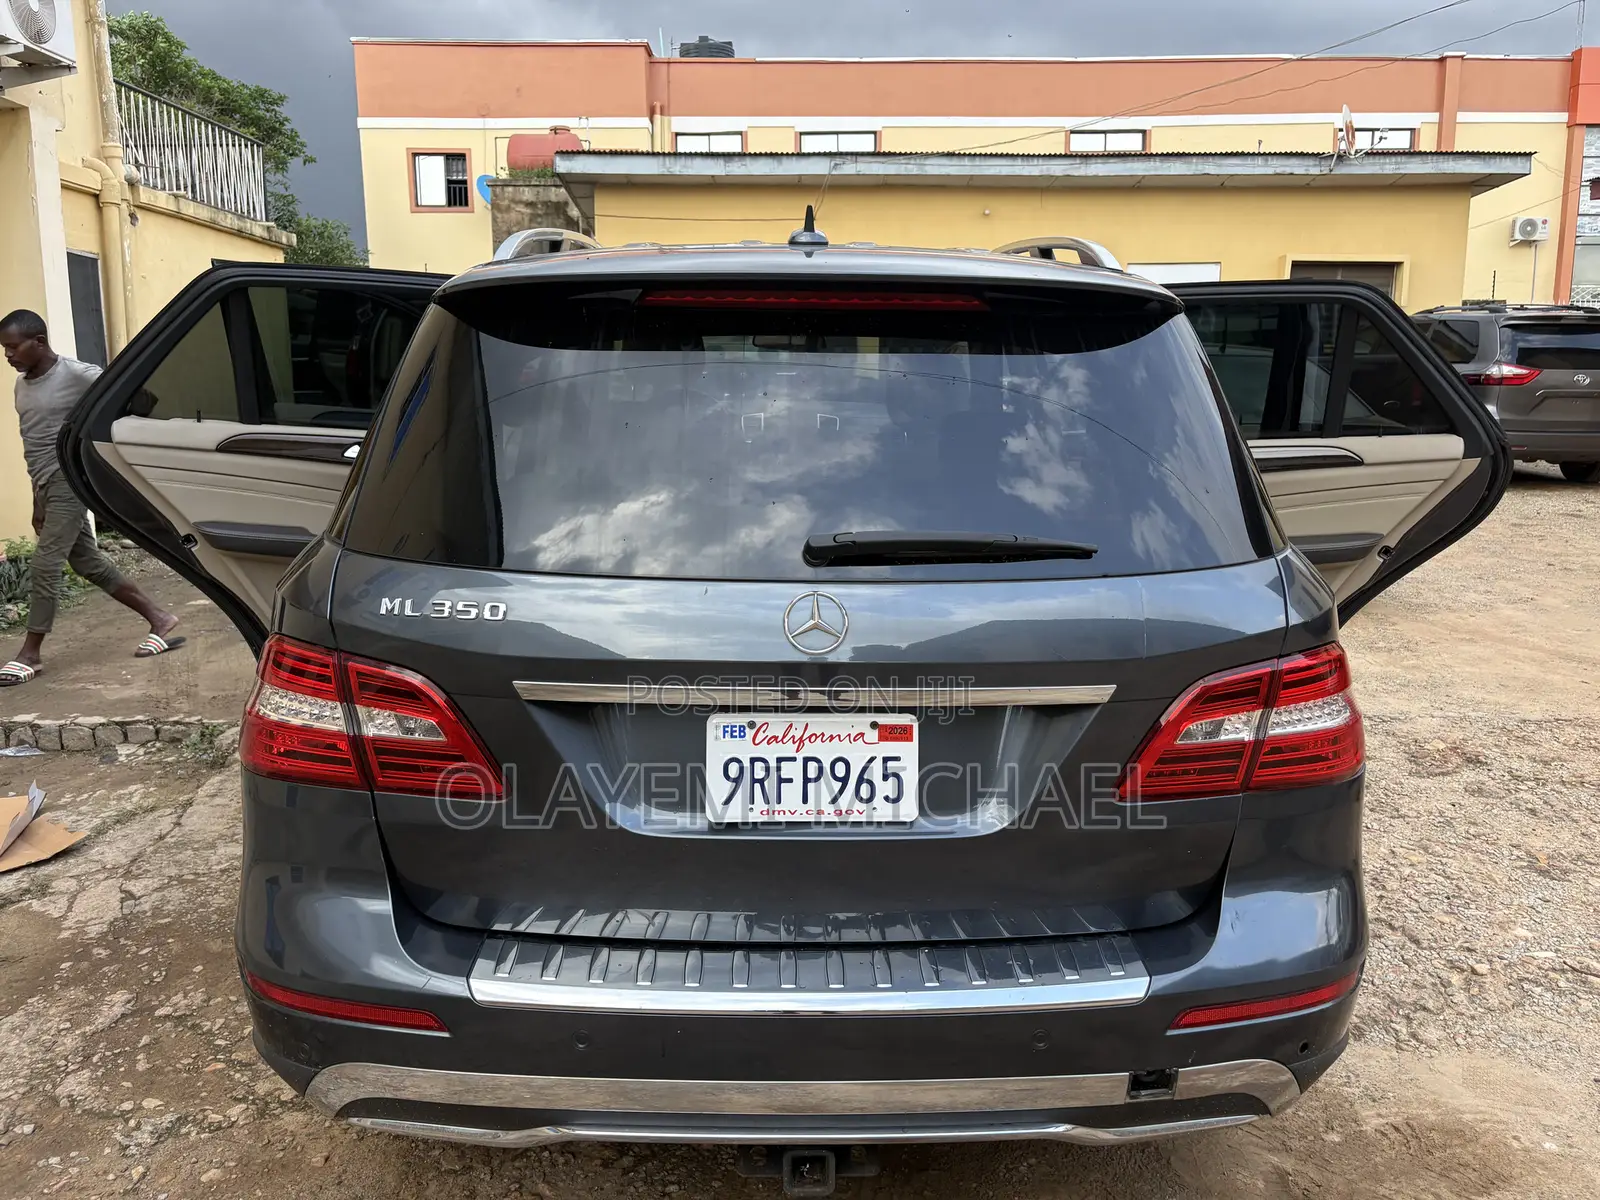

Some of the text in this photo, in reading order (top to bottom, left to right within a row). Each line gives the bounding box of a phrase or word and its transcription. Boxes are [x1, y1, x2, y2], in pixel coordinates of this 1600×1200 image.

[379, 597, 507, 621] ML 350
[722, 724, 747, 739] FEB
[751, 721, 880, 753] California
[888, 726, 908, 735] 2026
[721, 755, 905, 806] 9RFP965
[759, 807, 867, 817] dmv.ca.gov
